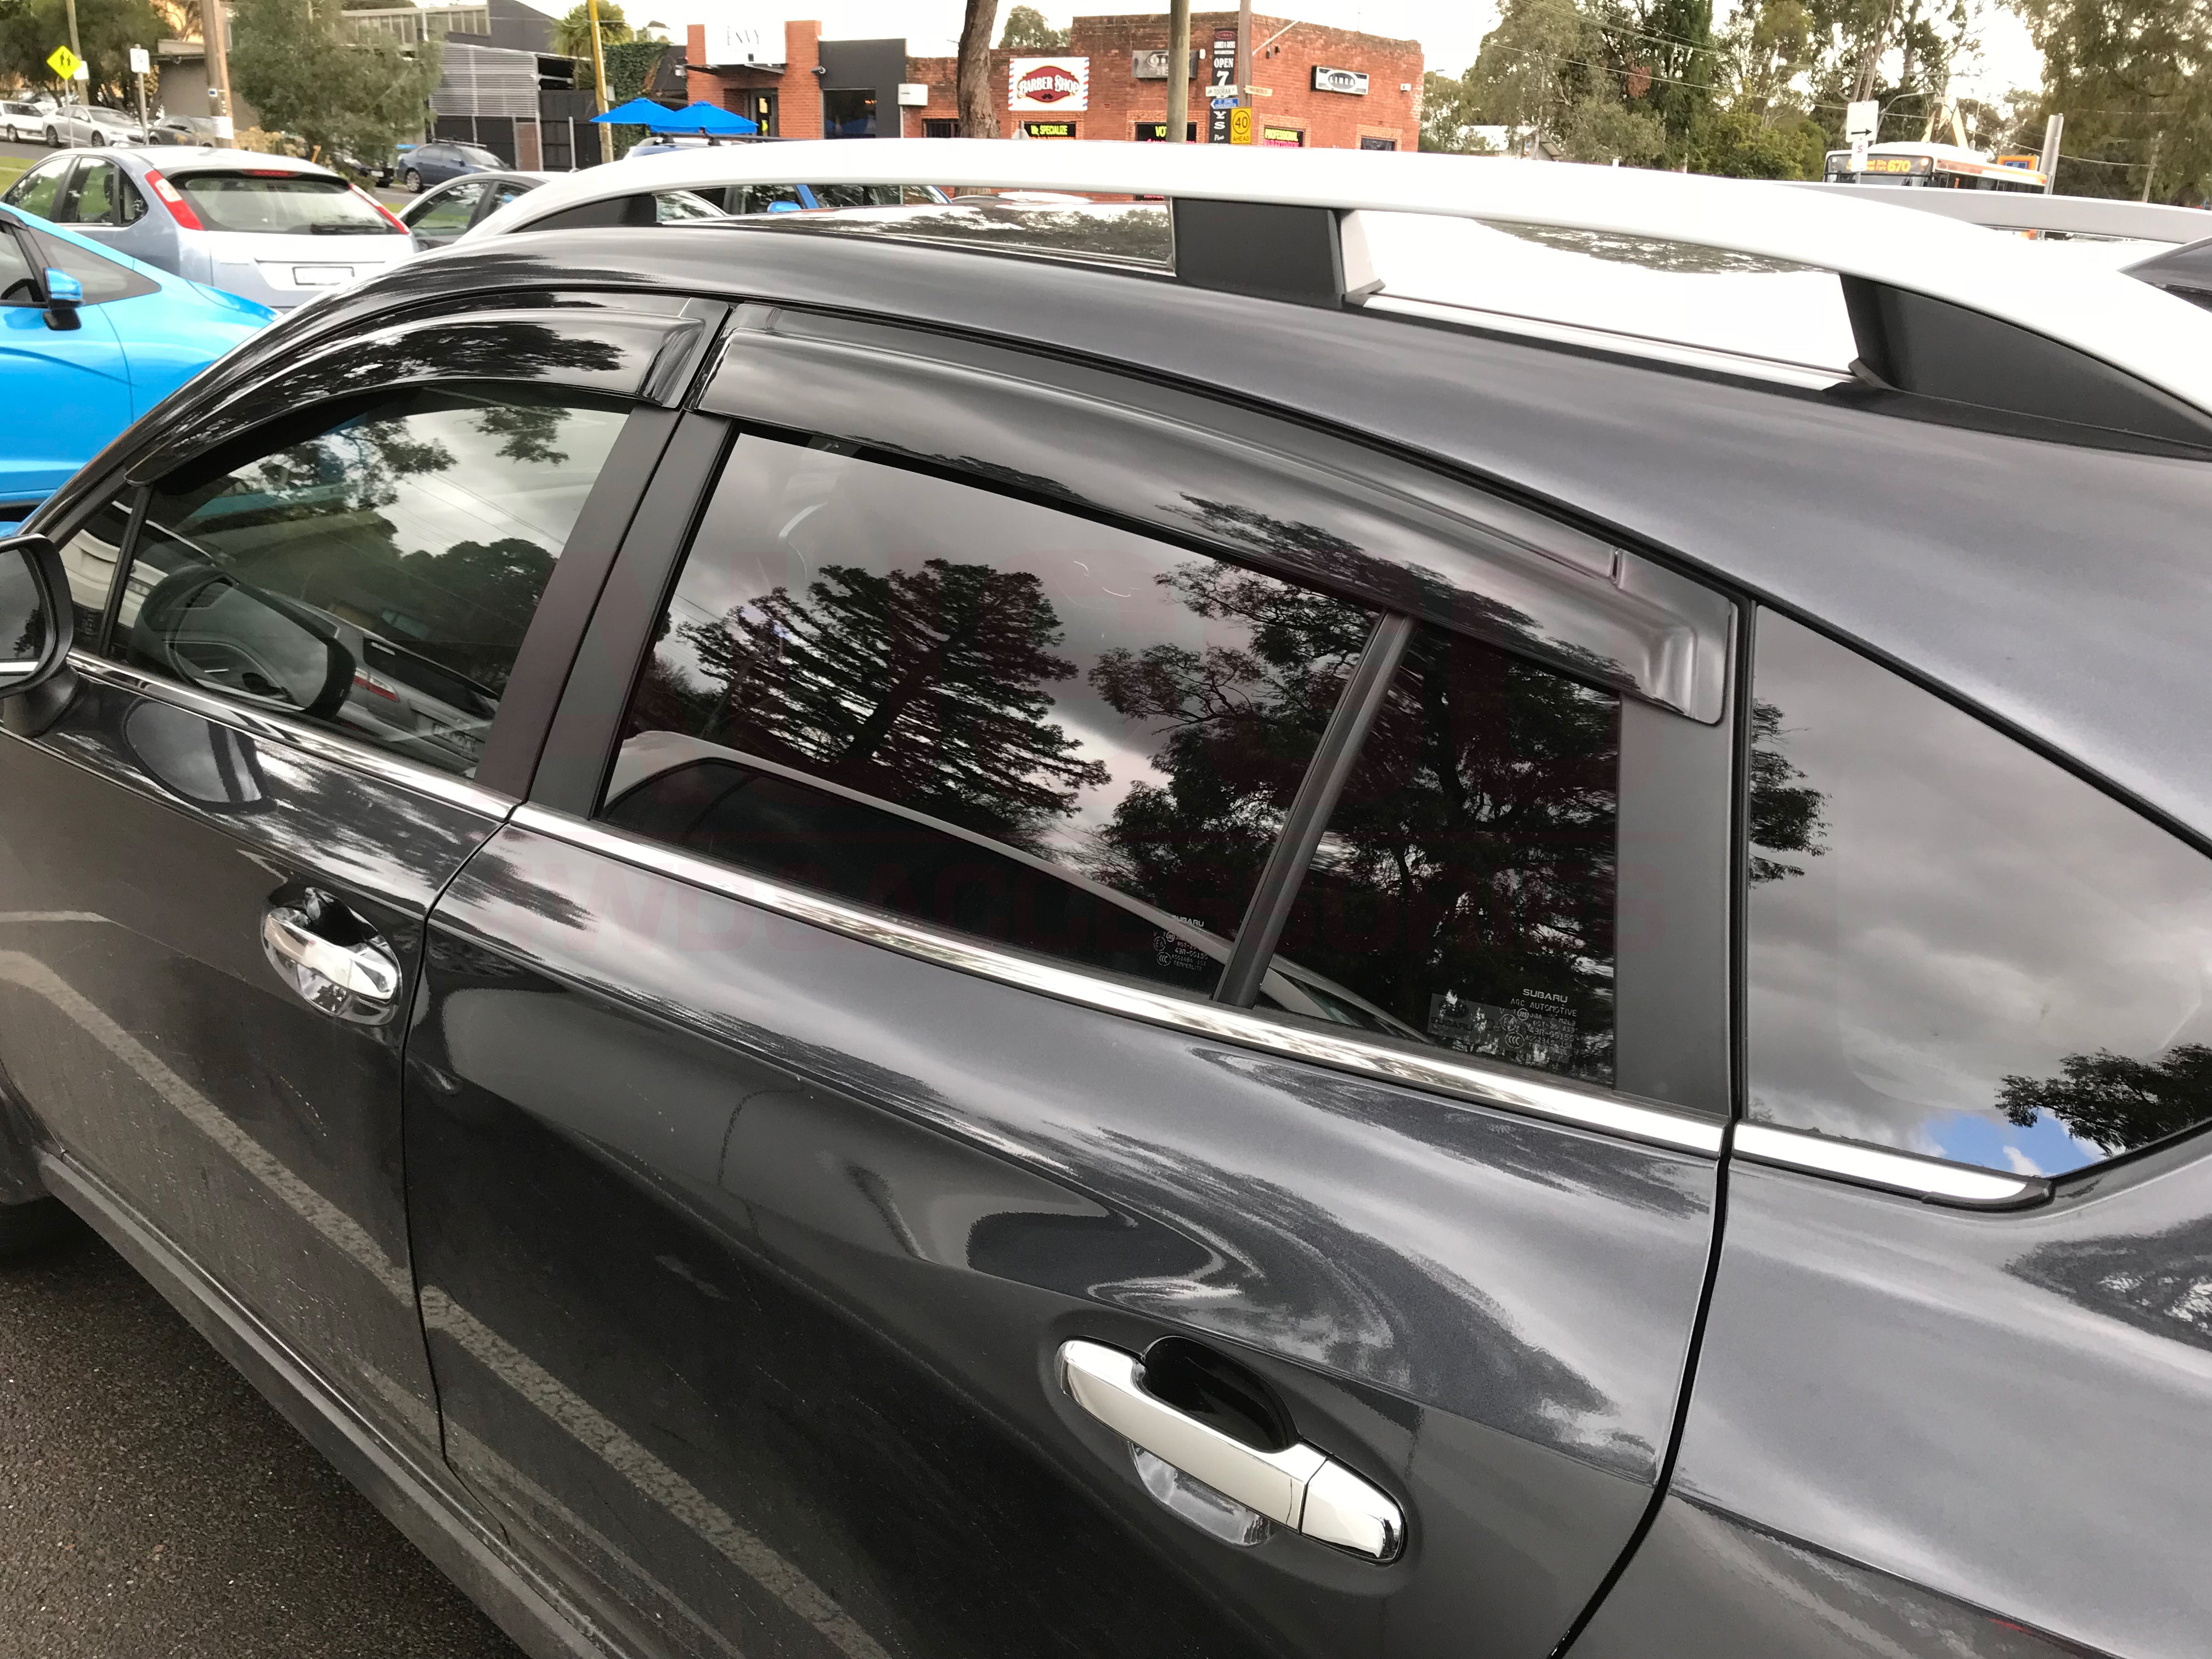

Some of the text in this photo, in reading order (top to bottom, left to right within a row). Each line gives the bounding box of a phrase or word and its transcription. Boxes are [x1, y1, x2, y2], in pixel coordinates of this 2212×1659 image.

[1214, 58, 1234, 68] OPEN
[1216, 70, 1229, 86] 7
[1018, 75, 1080, 97] BARBER SHOP
[1235, 117, 1248, 128] 40
[1040, 125, 1068, 135] SPECIALIZE
[1265, 128, 1299, 142] PROFESSIONAL
[1887, 160, 1911, 172] 670
[1171, 915, 1204, 927] SUBARU
[1522, 989, 1568, 1003] SUBARU
[1510, 998, 1577, 1017] AGC AUTOMOTIVE
